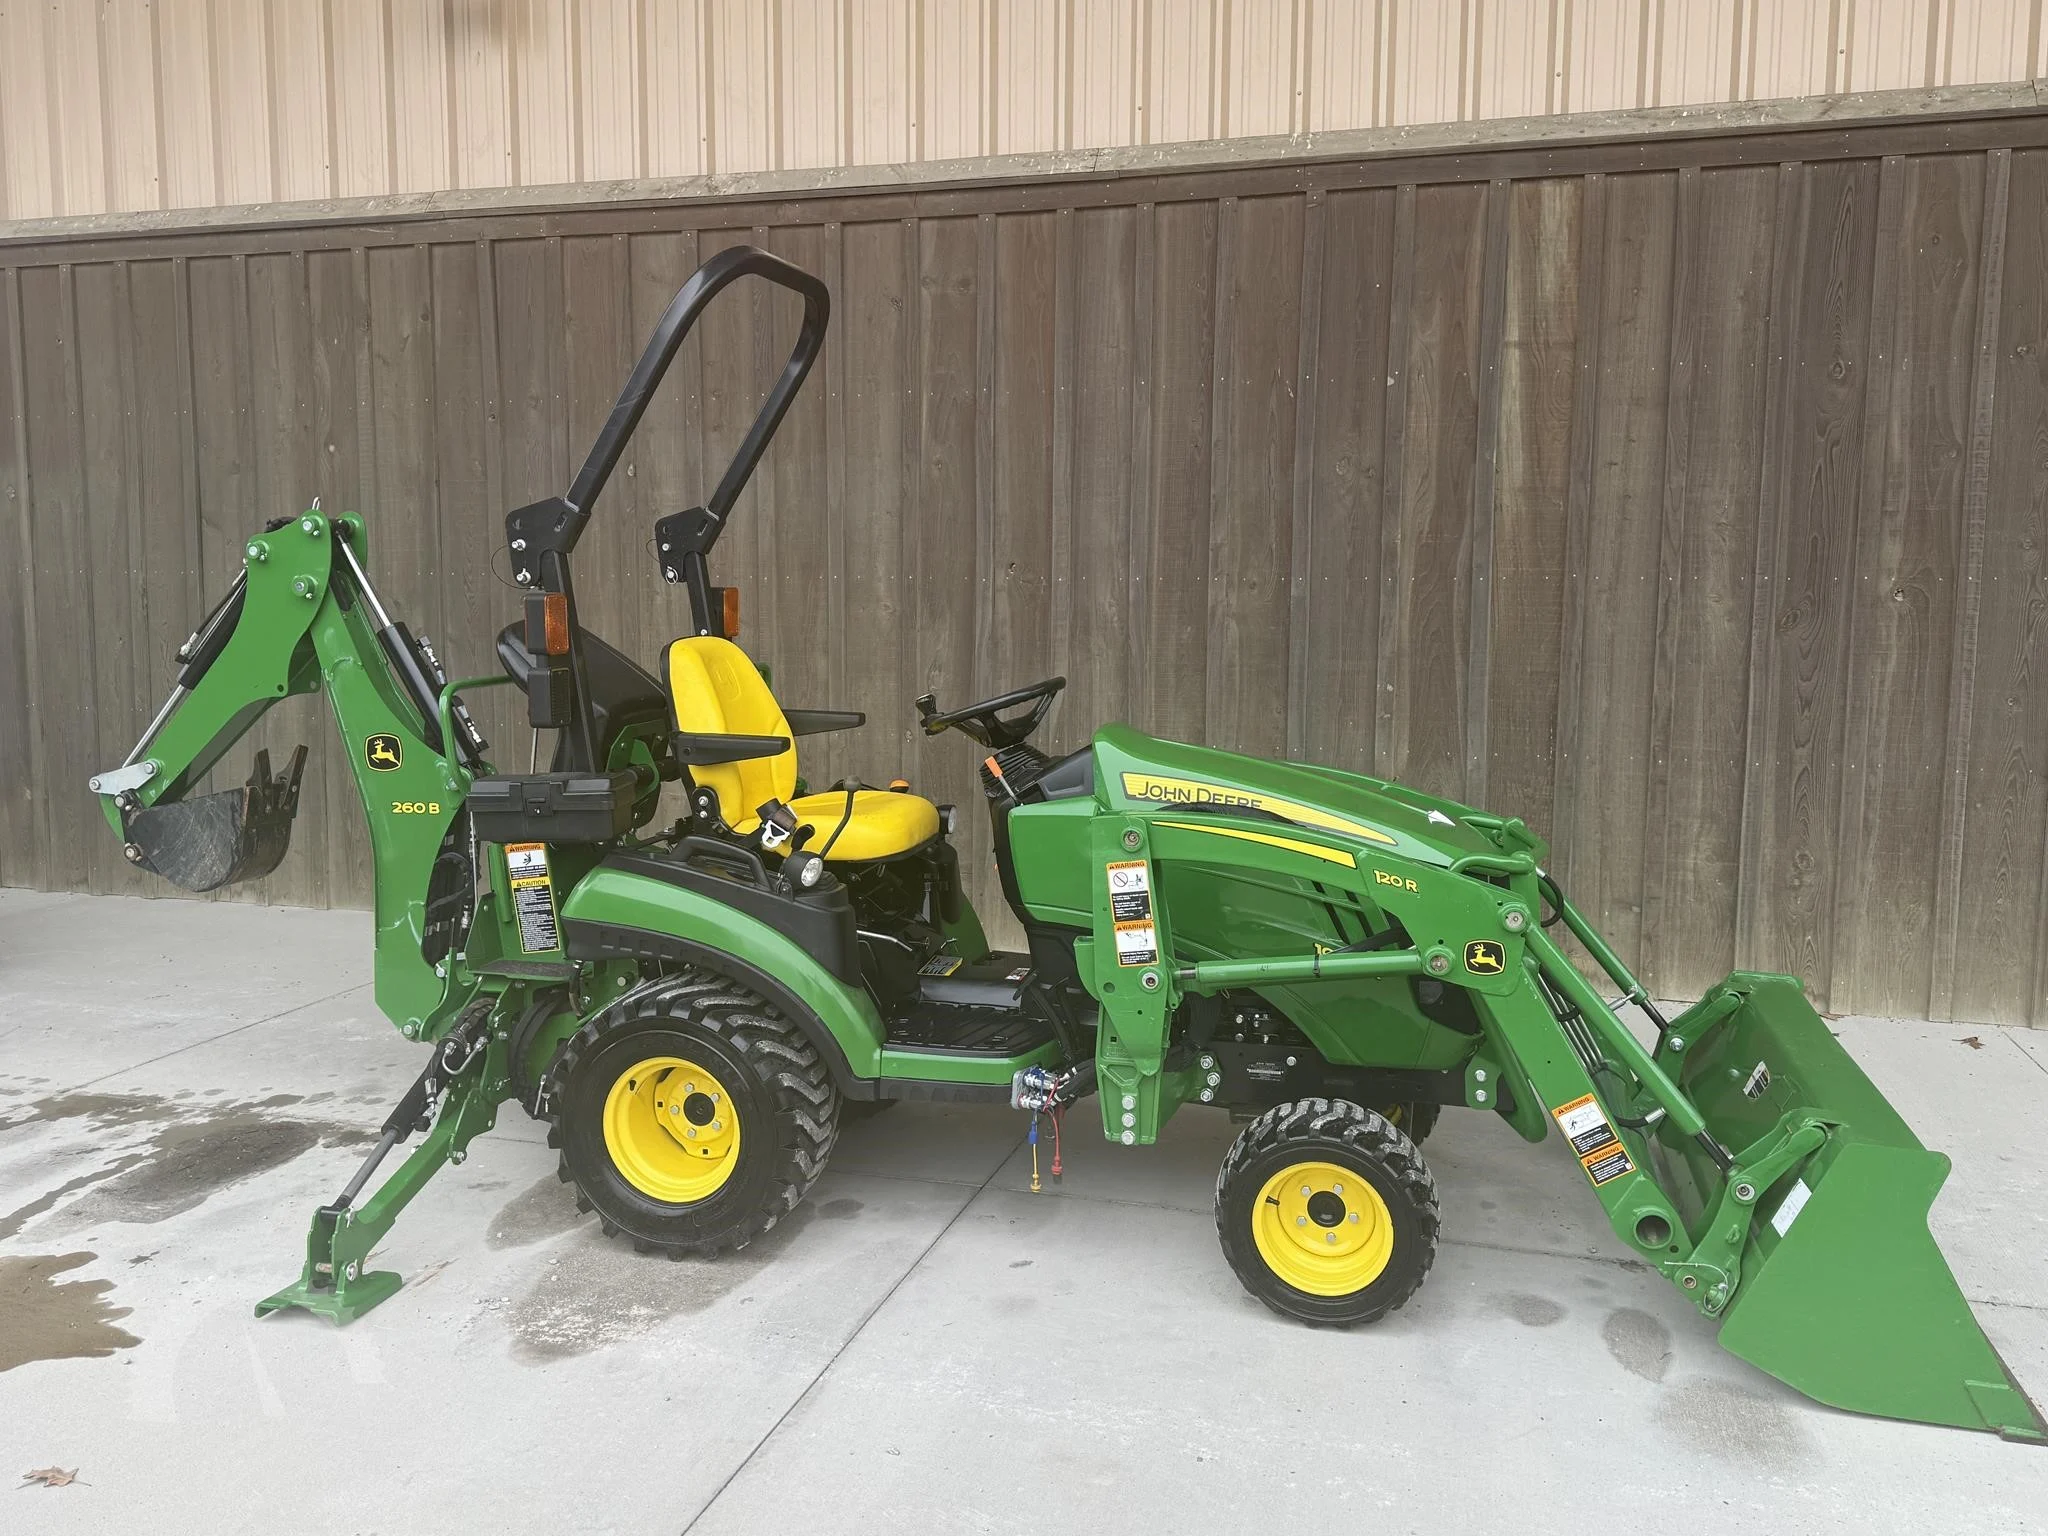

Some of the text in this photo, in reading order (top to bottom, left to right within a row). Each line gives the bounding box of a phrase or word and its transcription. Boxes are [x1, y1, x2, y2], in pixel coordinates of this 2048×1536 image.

[1138, 781, 1191, 802] JOHN
[391, 801, 440, 815] 260 B
[1114, 861, 1145, 869] WARNING
[1373, 869, 1419, 893] 120 R
[1121, 922, 1153, 930] WARNING
[1564, 1097, 1590, 1111] WARNING
[1593, 1146, 1620, 1161] WARNING
